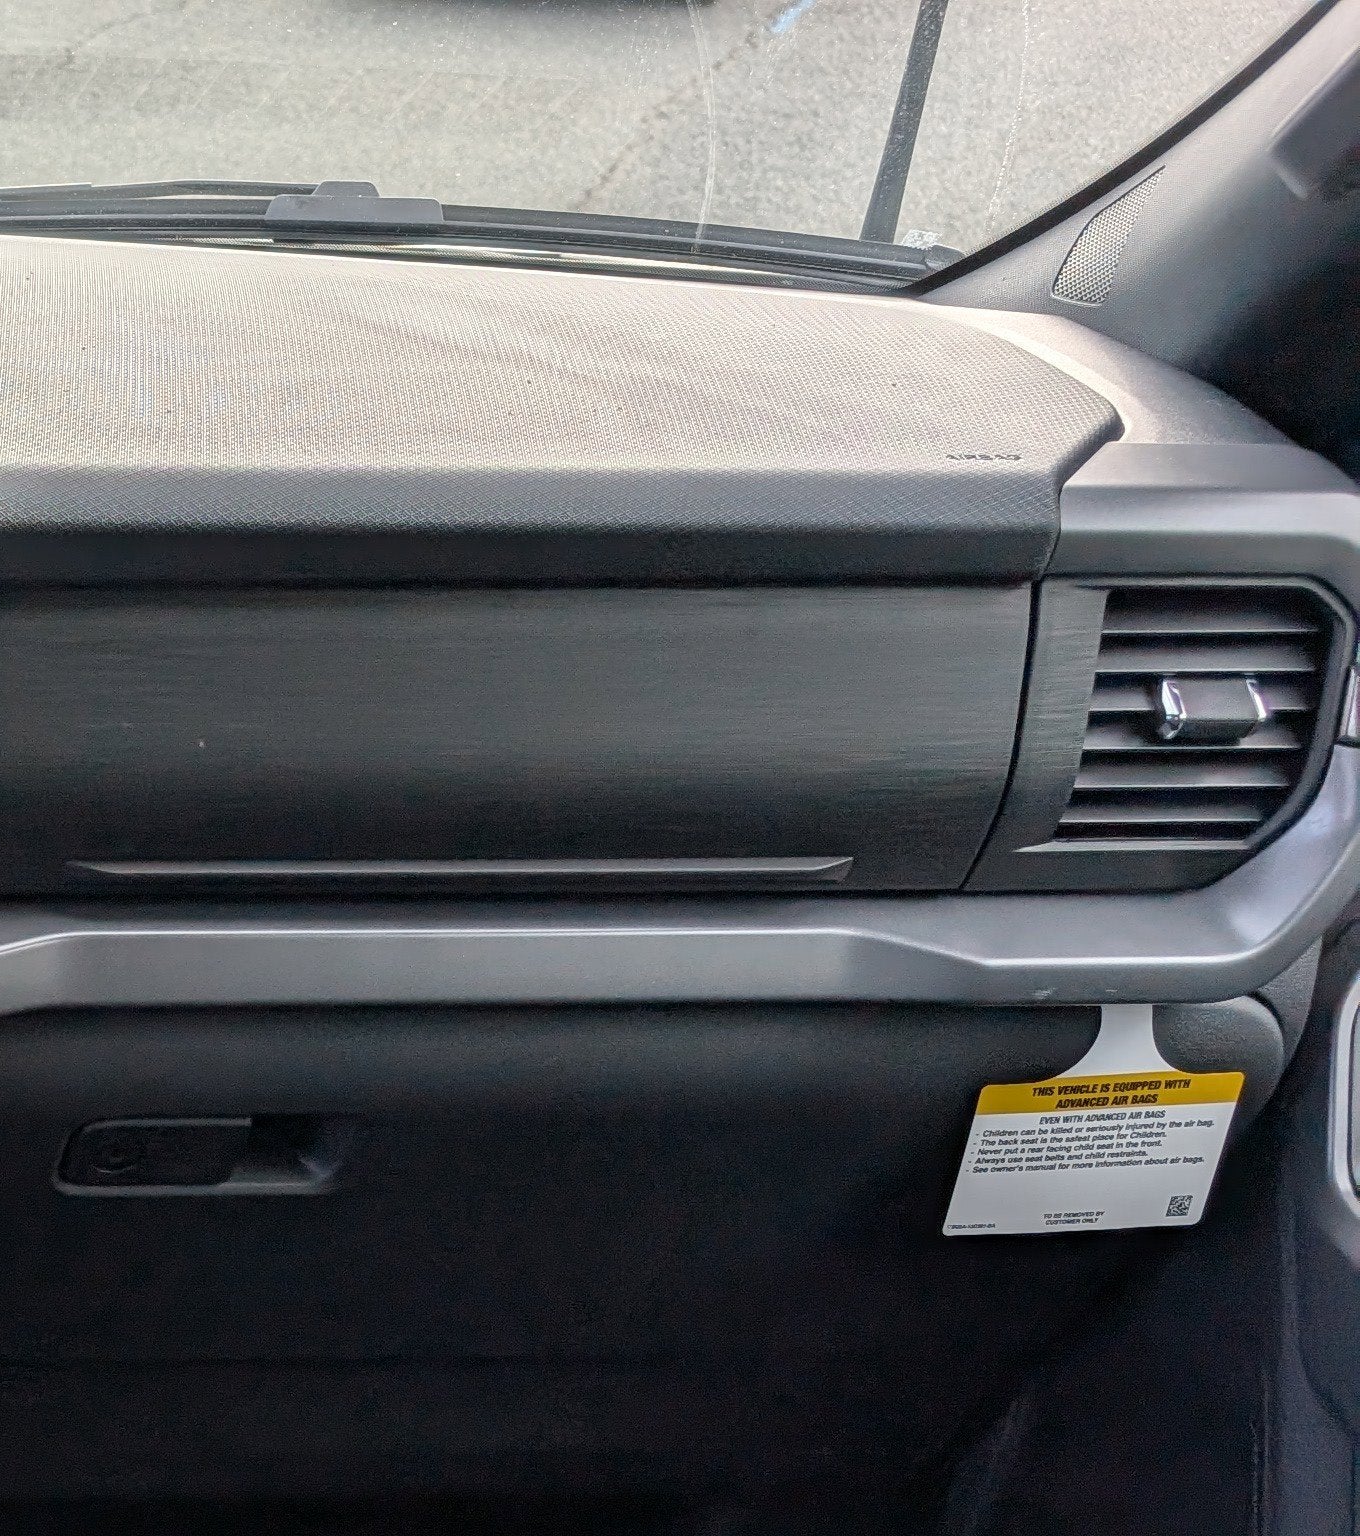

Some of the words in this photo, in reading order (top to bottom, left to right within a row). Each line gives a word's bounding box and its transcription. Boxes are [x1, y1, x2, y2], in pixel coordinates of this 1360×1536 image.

[1032, 1086, 1055, 1097] THIS
[1057, 1084, 1098, 1095] VEHICLE
[1100, 1083, 1110, 1093] IS
[1112, 1081, 1161, 1092] EQUIPPED
[1164, 1079, 1191, 1089] WITH
[1055, 1097, 1109, 1109] ADVANCED
[1111, 1095, 1129, 1106] AIR
[1131, 1094, 1158, 1104] BAGS
[1039, 1116, 1061, 1124] EVEN
[1062, 1115, 1083, 1123] WITH
[1085, 1113, 1127, 1122] ADVANCED
[1128, 1111, 1142, 1120] AIR
[1144, 1110, 1166, 1119] BAGS
[983, 1129, 1018, 1137] Children
[1050, 1126, 1073, 1134] killed
[1168, 1120, 1182, 1128] the
[998, 1138, 1018, 1146] back
[1074, 1143, 1095, 1151] child
[975, 1157, 1005, 1165] Always
[1025, 1163, 1056, 1171] manual
[1095, 1159, 1142, 1168] information
[1144, 1158, 1168, 1166] about
